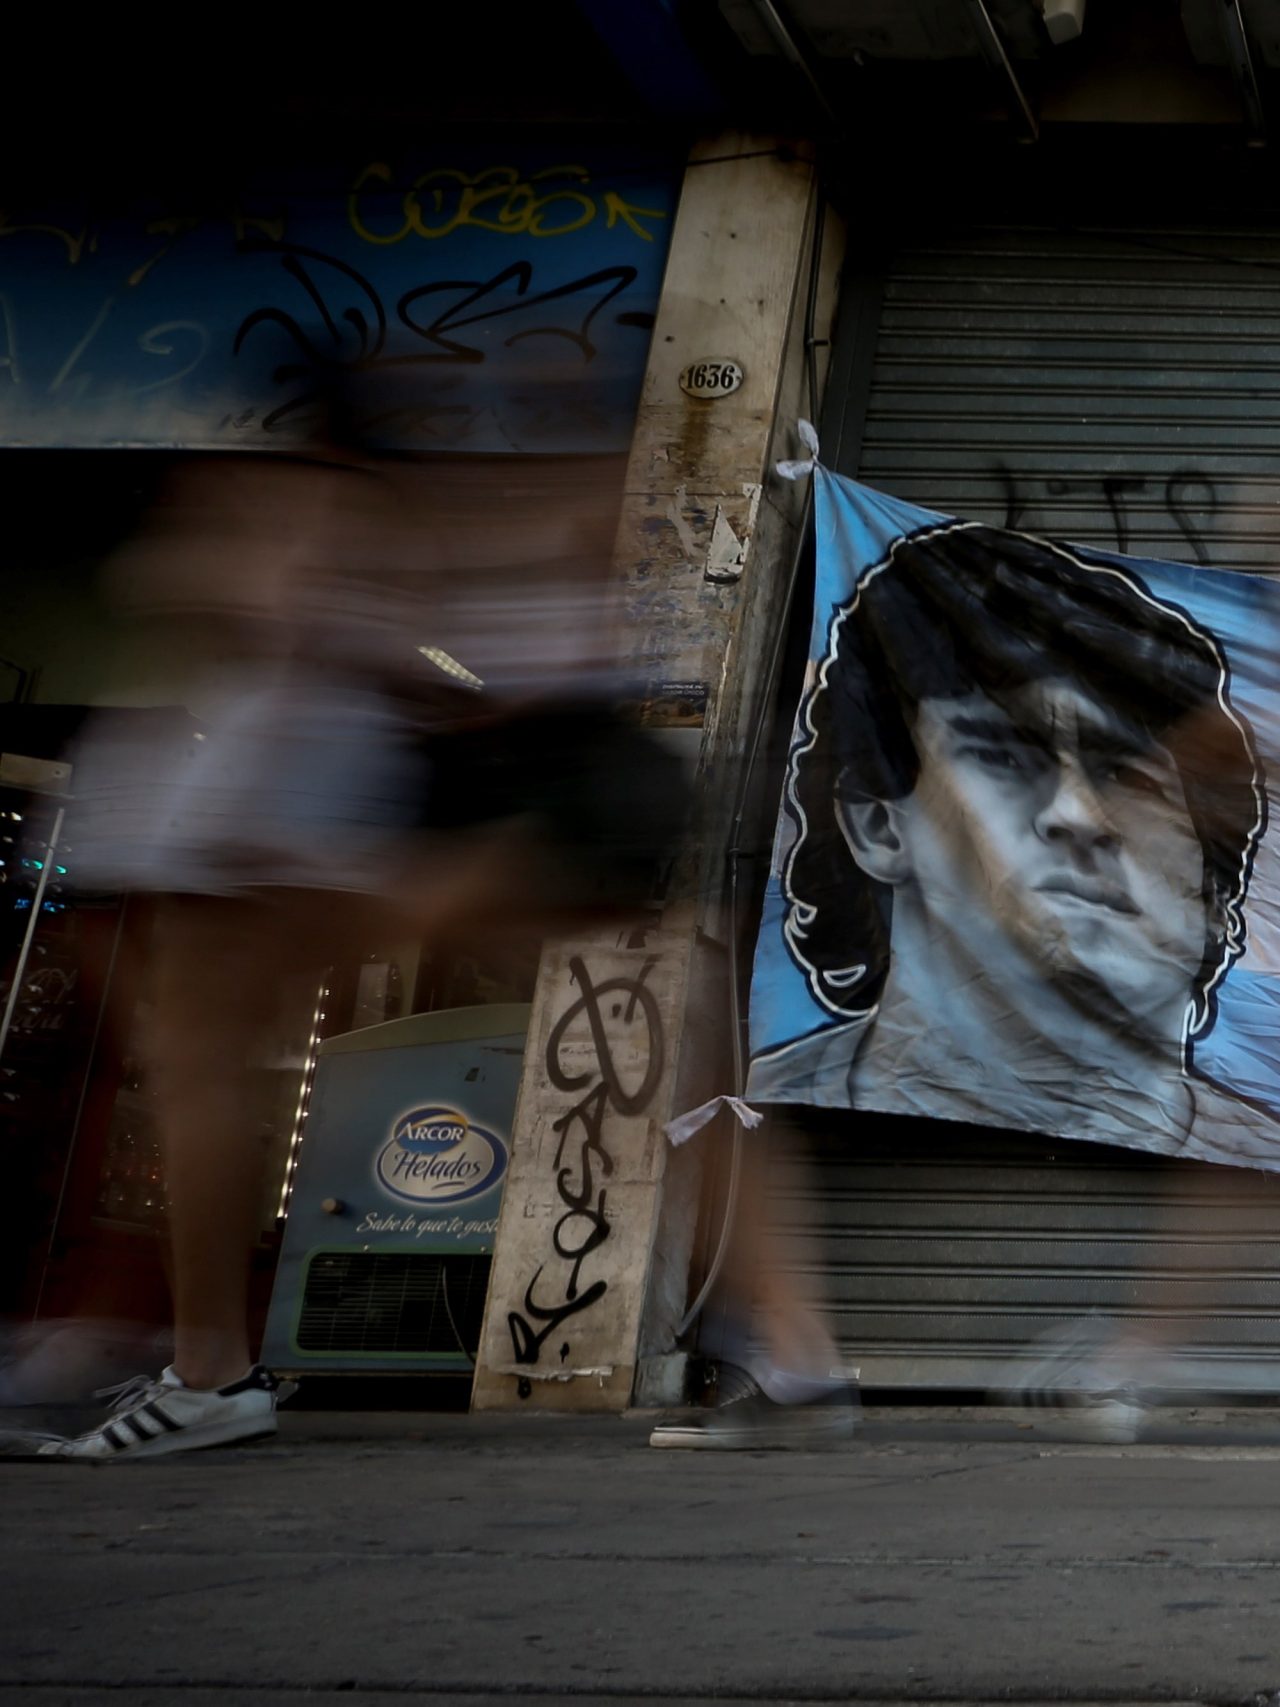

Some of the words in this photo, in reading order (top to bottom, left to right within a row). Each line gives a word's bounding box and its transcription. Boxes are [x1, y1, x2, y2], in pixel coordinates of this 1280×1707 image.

[687, 364, 735, 388] 1636
[398, 1122, 464, 1142] ARCOR
[393, 1152, 481, 1181] Helados
[356, 1212, 400, 1233] Sabe
[416, 1219, 447, 1238] que
[457, 1218, 498, 1239] gust
